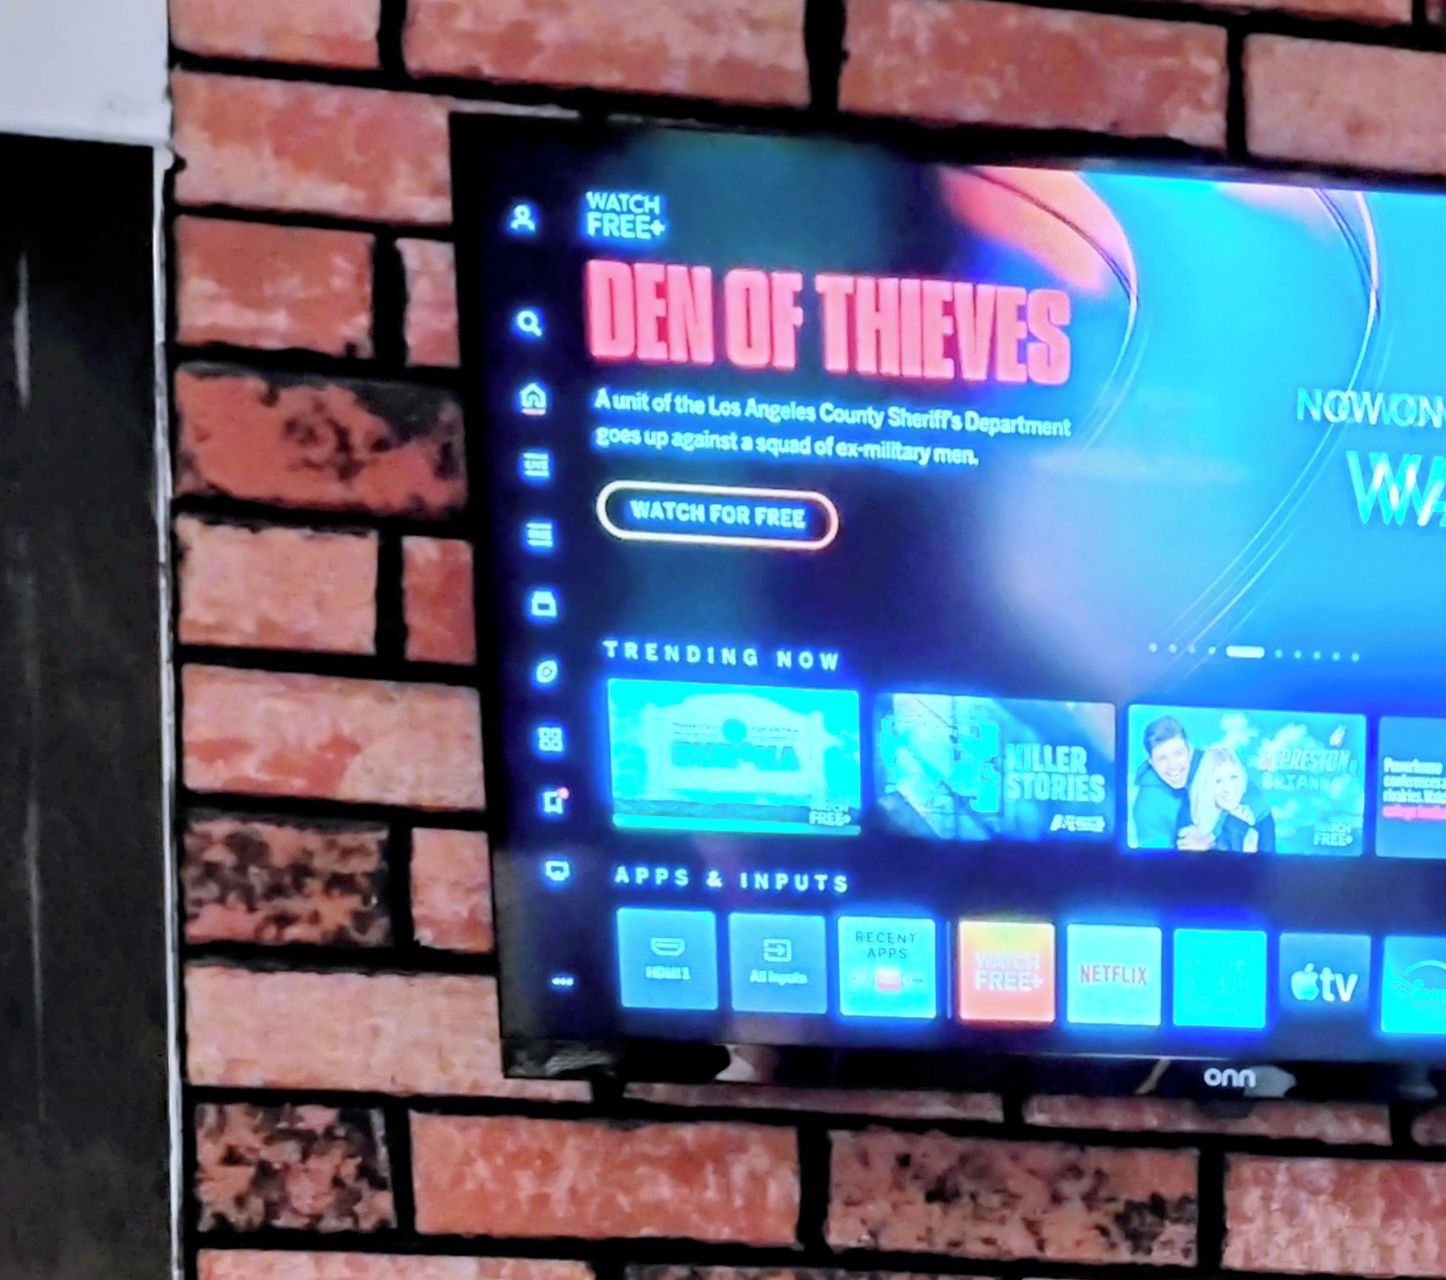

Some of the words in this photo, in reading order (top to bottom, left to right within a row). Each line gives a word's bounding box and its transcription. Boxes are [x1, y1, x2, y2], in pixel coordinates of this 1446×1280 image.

[586, 191, 661, 215] WATCH
[587, 212, 666, 239] FREE+
[586, 259, 714, 365] DEN
[724, 268, 804, 371] OF
[815, 274, 1071, 385] THIEVES
[594, 387, 611, 409] A
[613, 391, 650, 412] unit
[652, 392, 672, 412] of
[675, 393, 705, 414] the
[708, 396, 742, 417] Los
[745, 398, 816, 423] Angeles
[818, 402, 884, 429] County
[887, 406, 962, 431] Sheriff's
[965, 411, 1072, 437] Department
[596, 427, 641, 448] goes
[644, 430, 669, 449] up
[671, 430, 738, 452] against
[740, 436, 753, 451] a
[755, 436, 811, 457] squad
[814, 436, 835, 456] of
[836, 440, 931, 466] ex-military
[933, 447, 979, 466] men.
[630, 500, 705, 522] WATCH
[709, 504, 749, 525] FOR
[754, 506, 807, 529] FREE
[602, 639, 759, 667] TRENDING
[776, 649, 839, 672] NOW
[1005, 743, 1088, 774] KILLER
[1005, 771, 1107, 803] STORIES
[614, 866, 690, 887] APPS
[706, 870, 722, 888] &
[740, 872, 849, 893] INPUTS
[855, 931, 918, 945] RECENT
[866, 948, 908, 960] APPS
[974, 952, 1040, 971] WATCH
[975, 969, 1045, 992] FREE+
[1080, 964, 1148, 986] NETFLIX
[1319, 966, 1359, 1003] tv
[1203, 1067, 1257, 1088] onn
